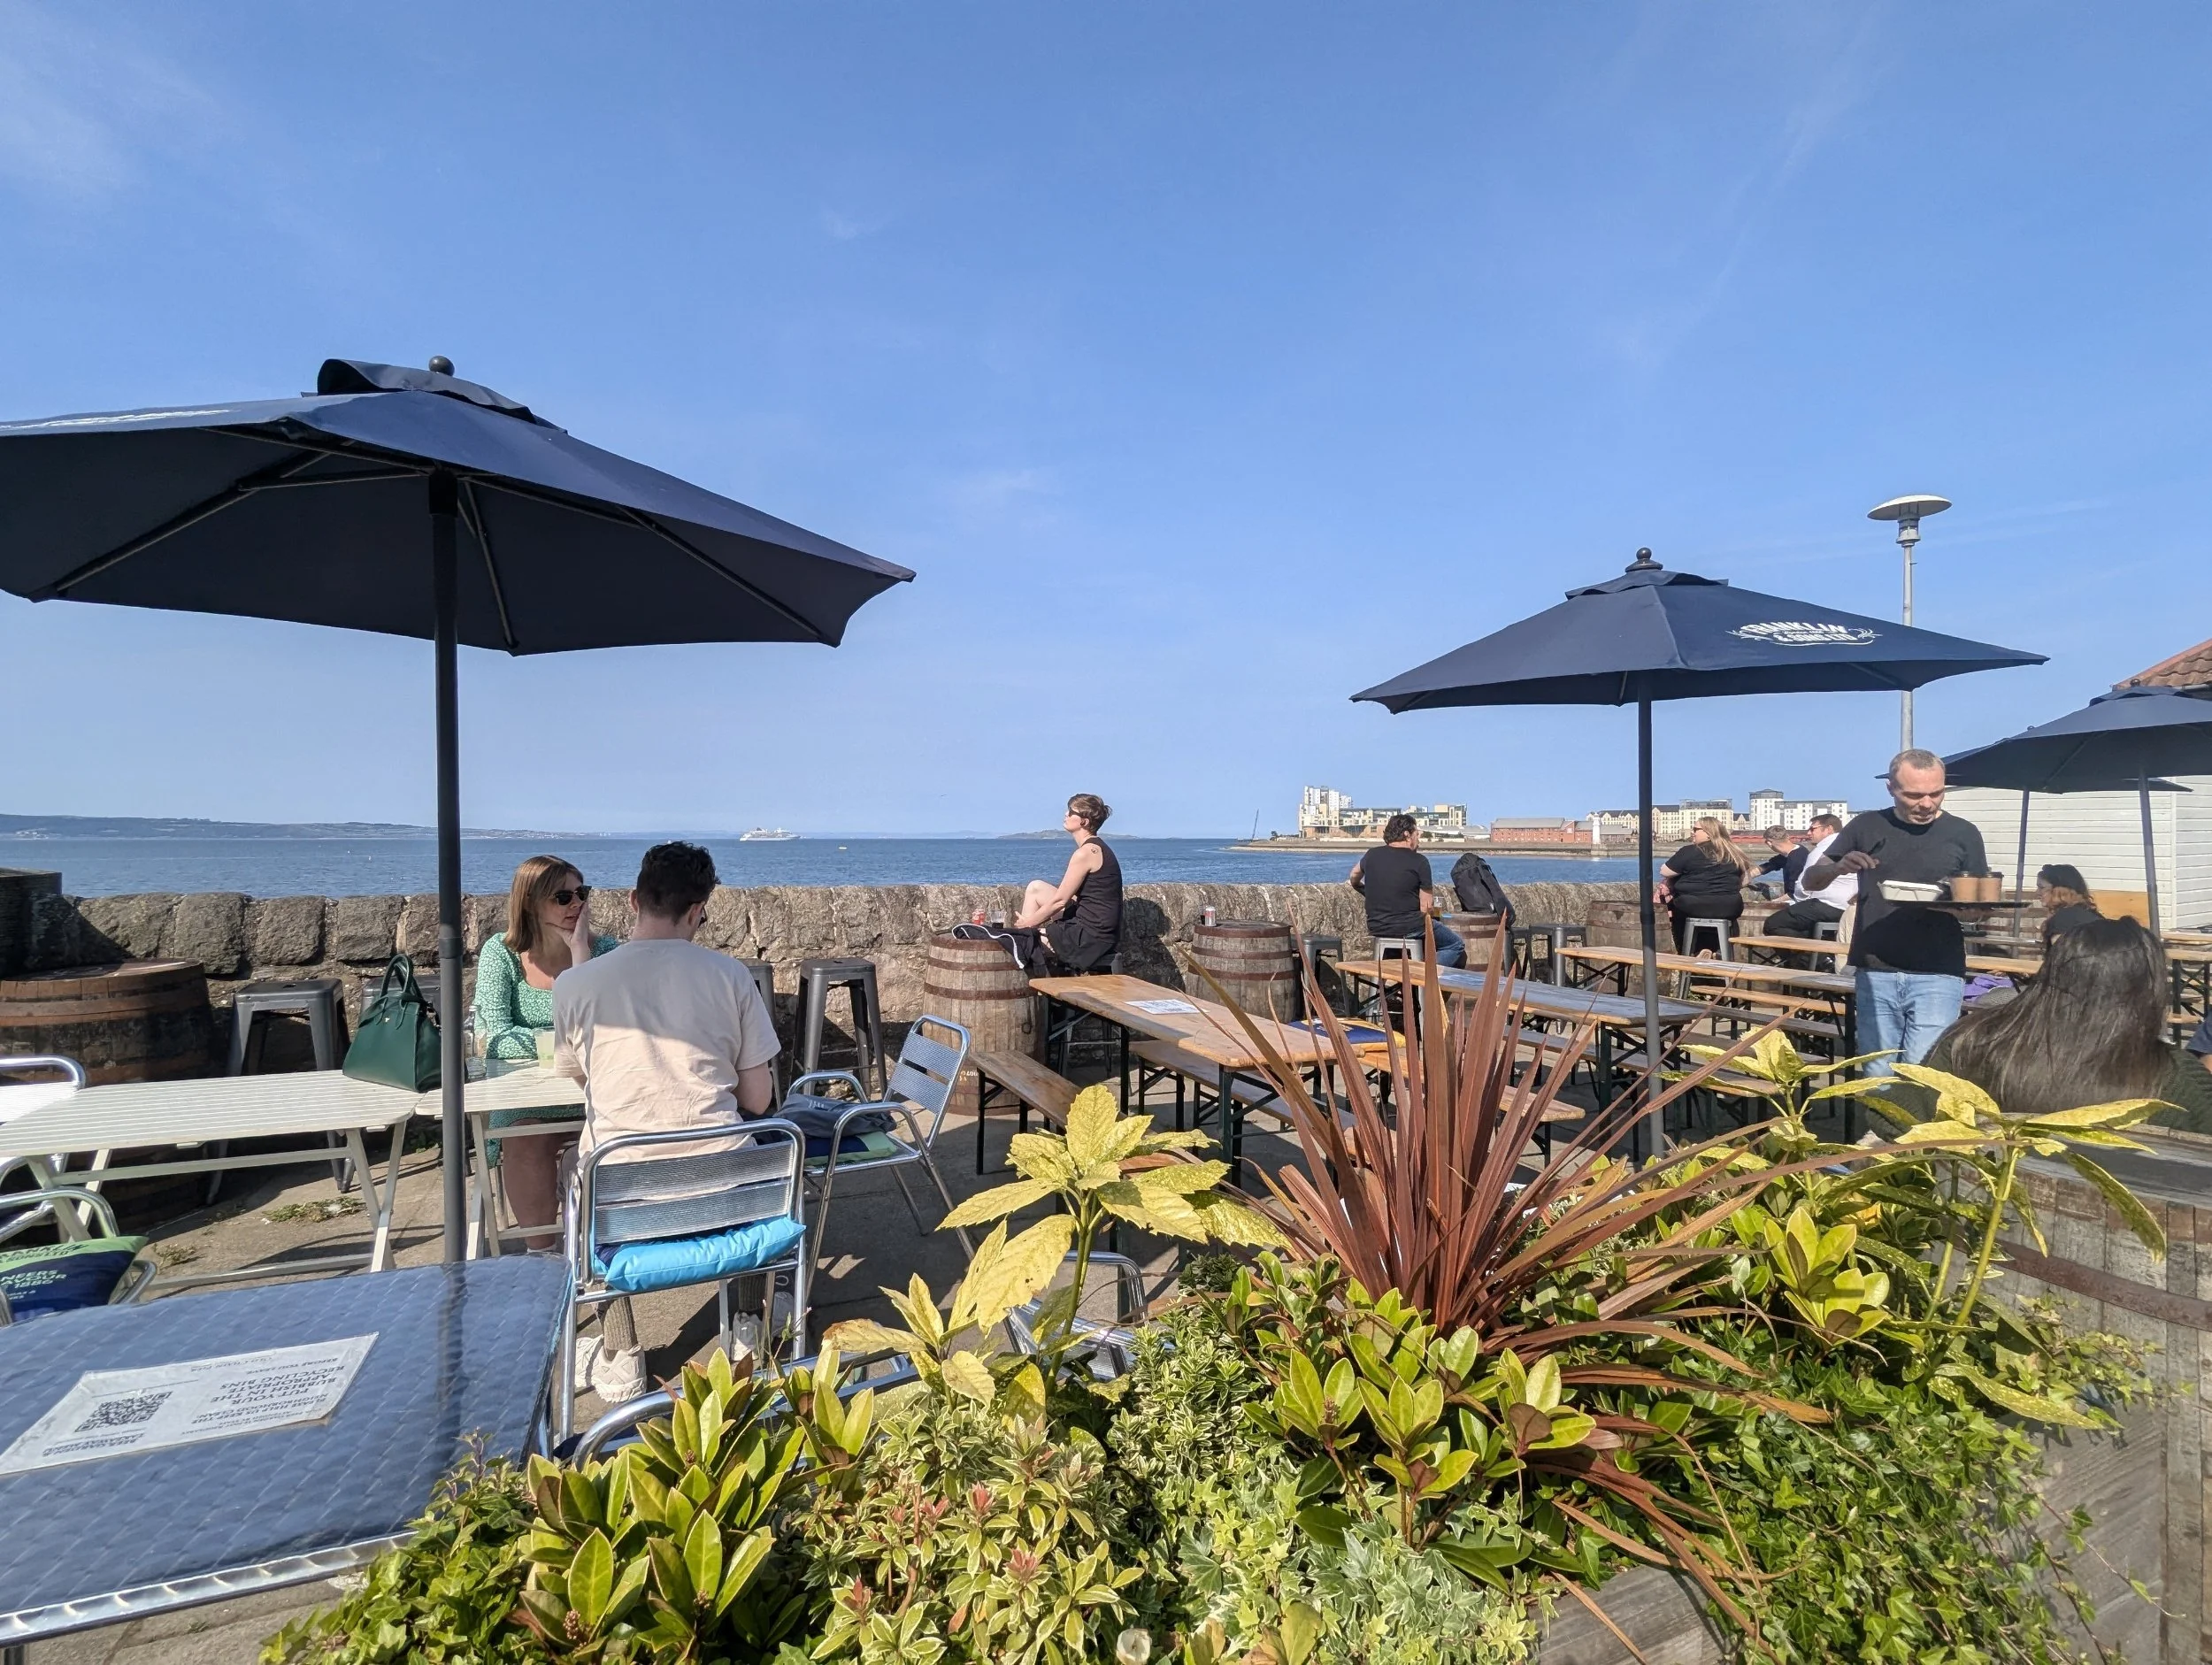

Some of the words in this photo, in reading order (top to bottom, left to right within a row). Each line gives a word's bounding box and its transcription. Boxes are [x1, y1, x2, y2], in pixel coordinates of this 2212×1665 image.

[1740, 622, 1848, 635] FRANKLIN
[258, 1365, 346, 1383] RECYCLING
[218, 1378, 257, 1389] BINS
[227, 1373, 331, 1393] APPROPRIATE
[270, 1377, 337, 1393] RUBBISH
[208, 1393, 243, 1402] THE
[278, 1387, 310, 1397] PUT
[228, 1393, 276, 1405] YOUR
